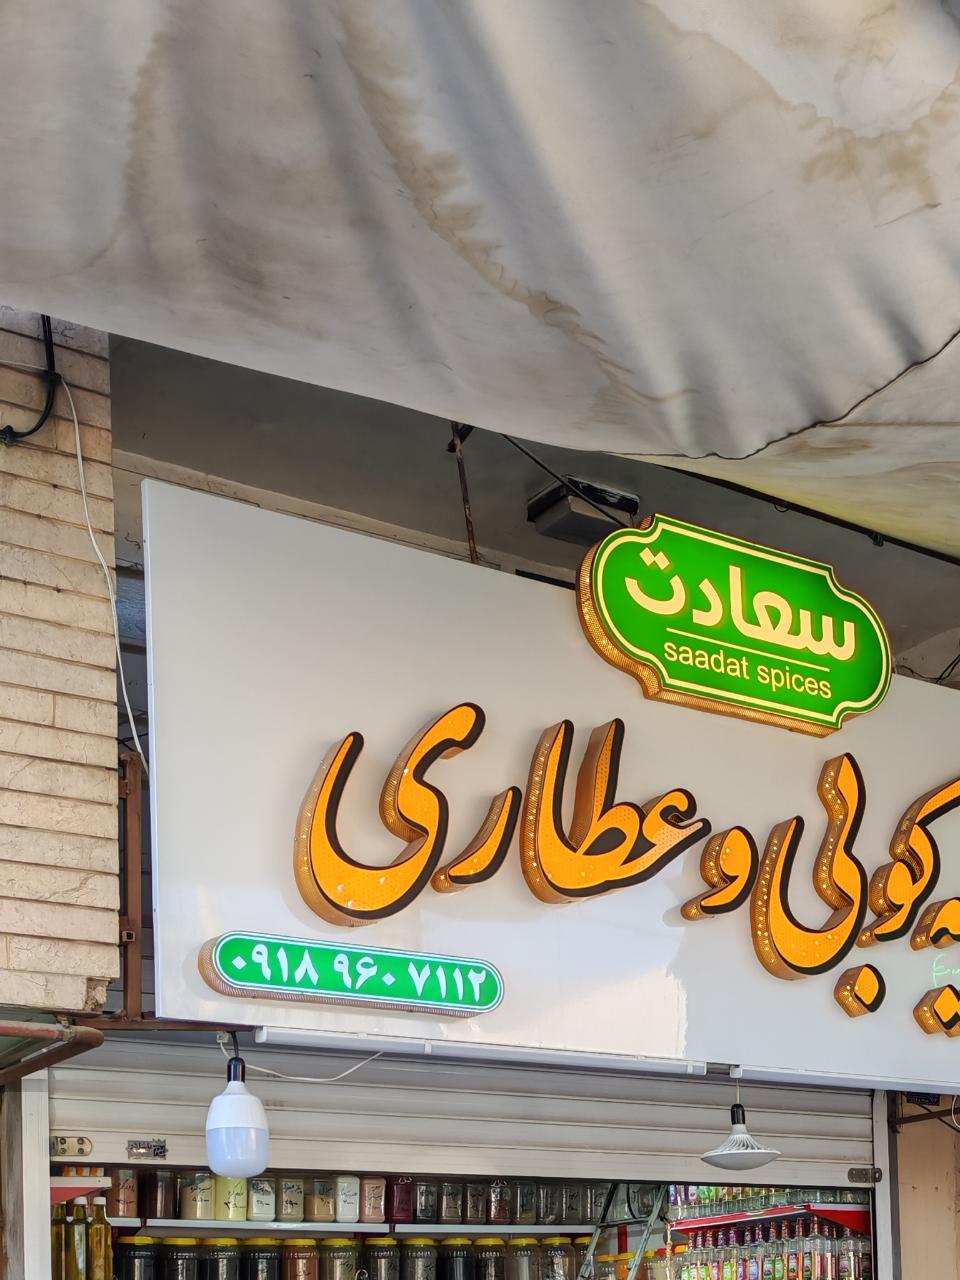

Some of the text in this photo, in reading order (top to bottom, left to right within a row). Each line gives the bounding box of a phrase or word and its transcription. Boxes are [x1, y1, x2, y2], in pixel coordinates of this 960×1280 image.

[624, 547, 856, 661] سعادت
[663, 641, 833, 700] saadat spices
[293, 702, 712, 927] عطاری
[681, 825, 759, 921] و
[231, 943, 486, 1003] ۰۹۱۸ ۹۶۰ ۷۱۱۲
